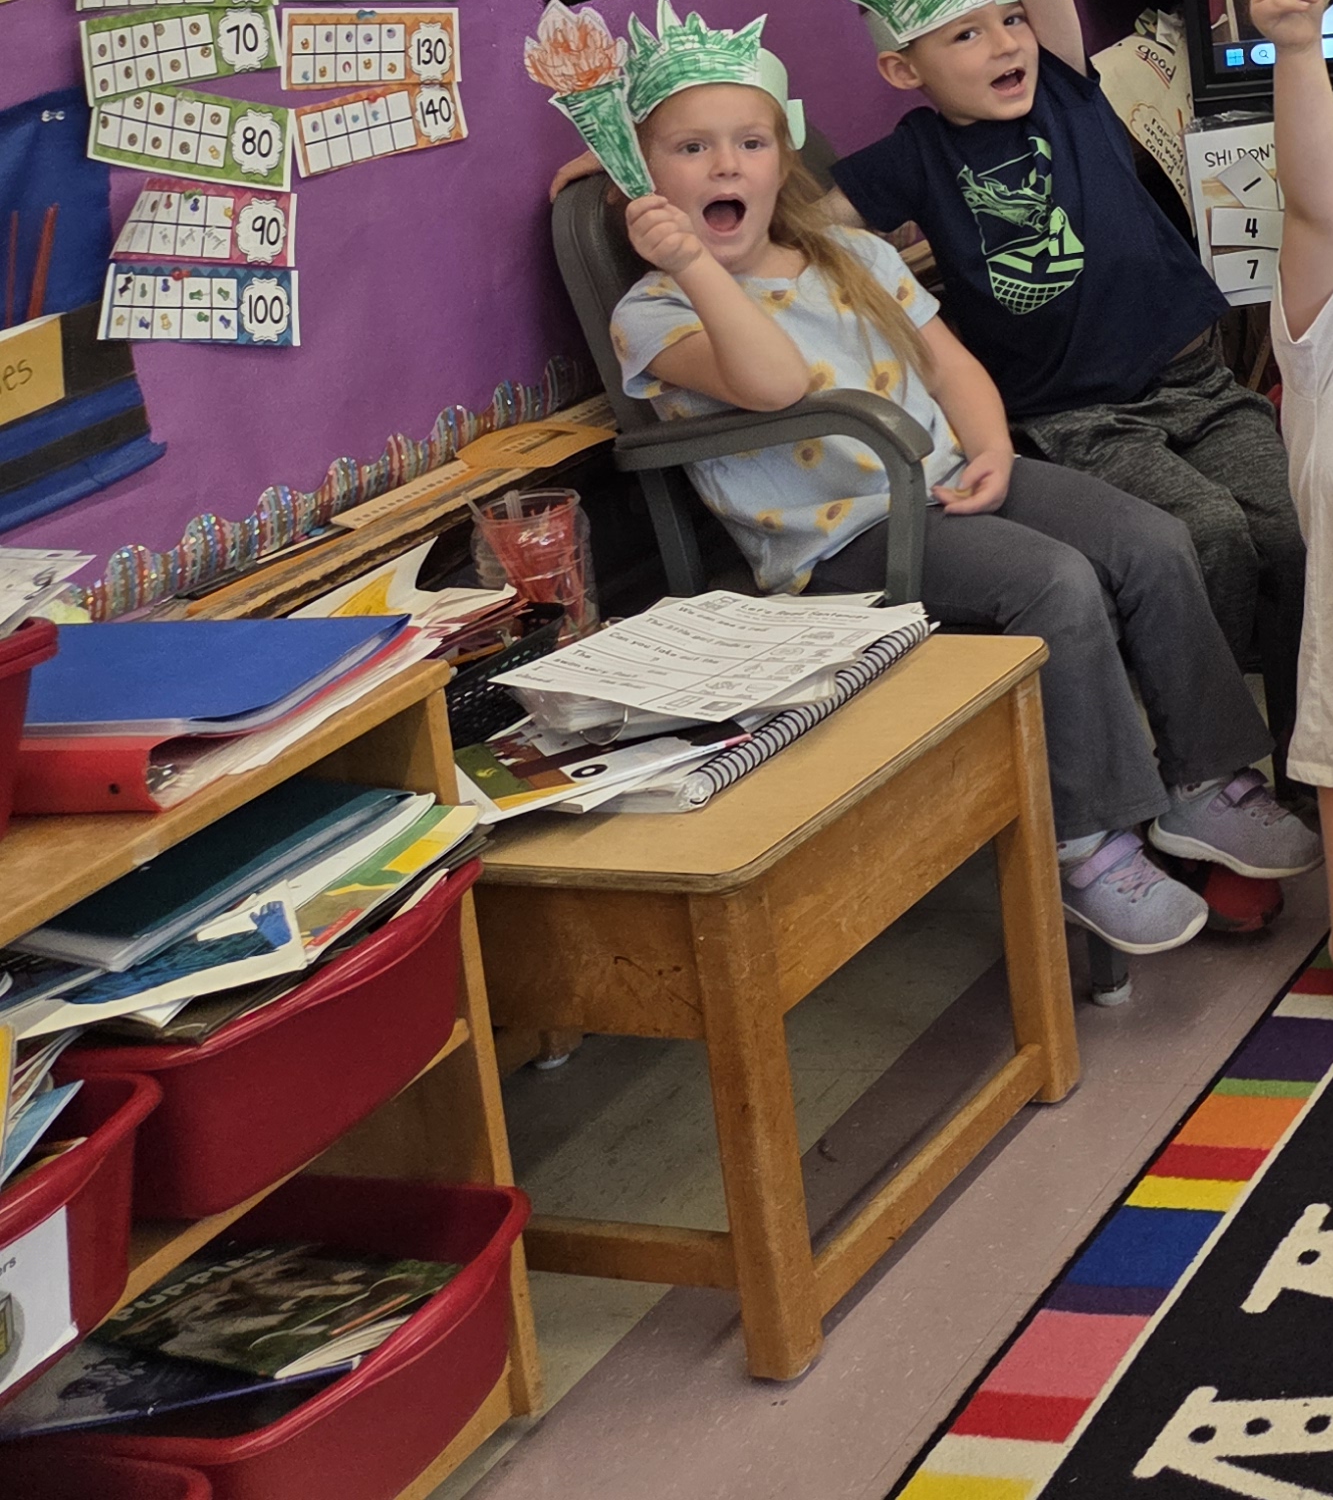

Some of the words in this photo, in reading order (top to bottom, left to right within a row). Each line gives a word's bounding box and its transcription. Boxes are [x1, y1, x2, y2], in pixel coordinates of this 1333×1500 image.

[228, 22, 258, 55] 70
[417, 35, 446, 65] 130
[1137, 44, 1177, 80] good
[420, 97, 451, 128] 140
[241, 126, 272, 159] 80
[1204, 150, 1233, 168] SH!
[251, 215, 280, 246] 90
[1245, 218, 1258, 238] 4
[1247, 259, 1258, 279] 7
[248, 293, 283, 324] 100
